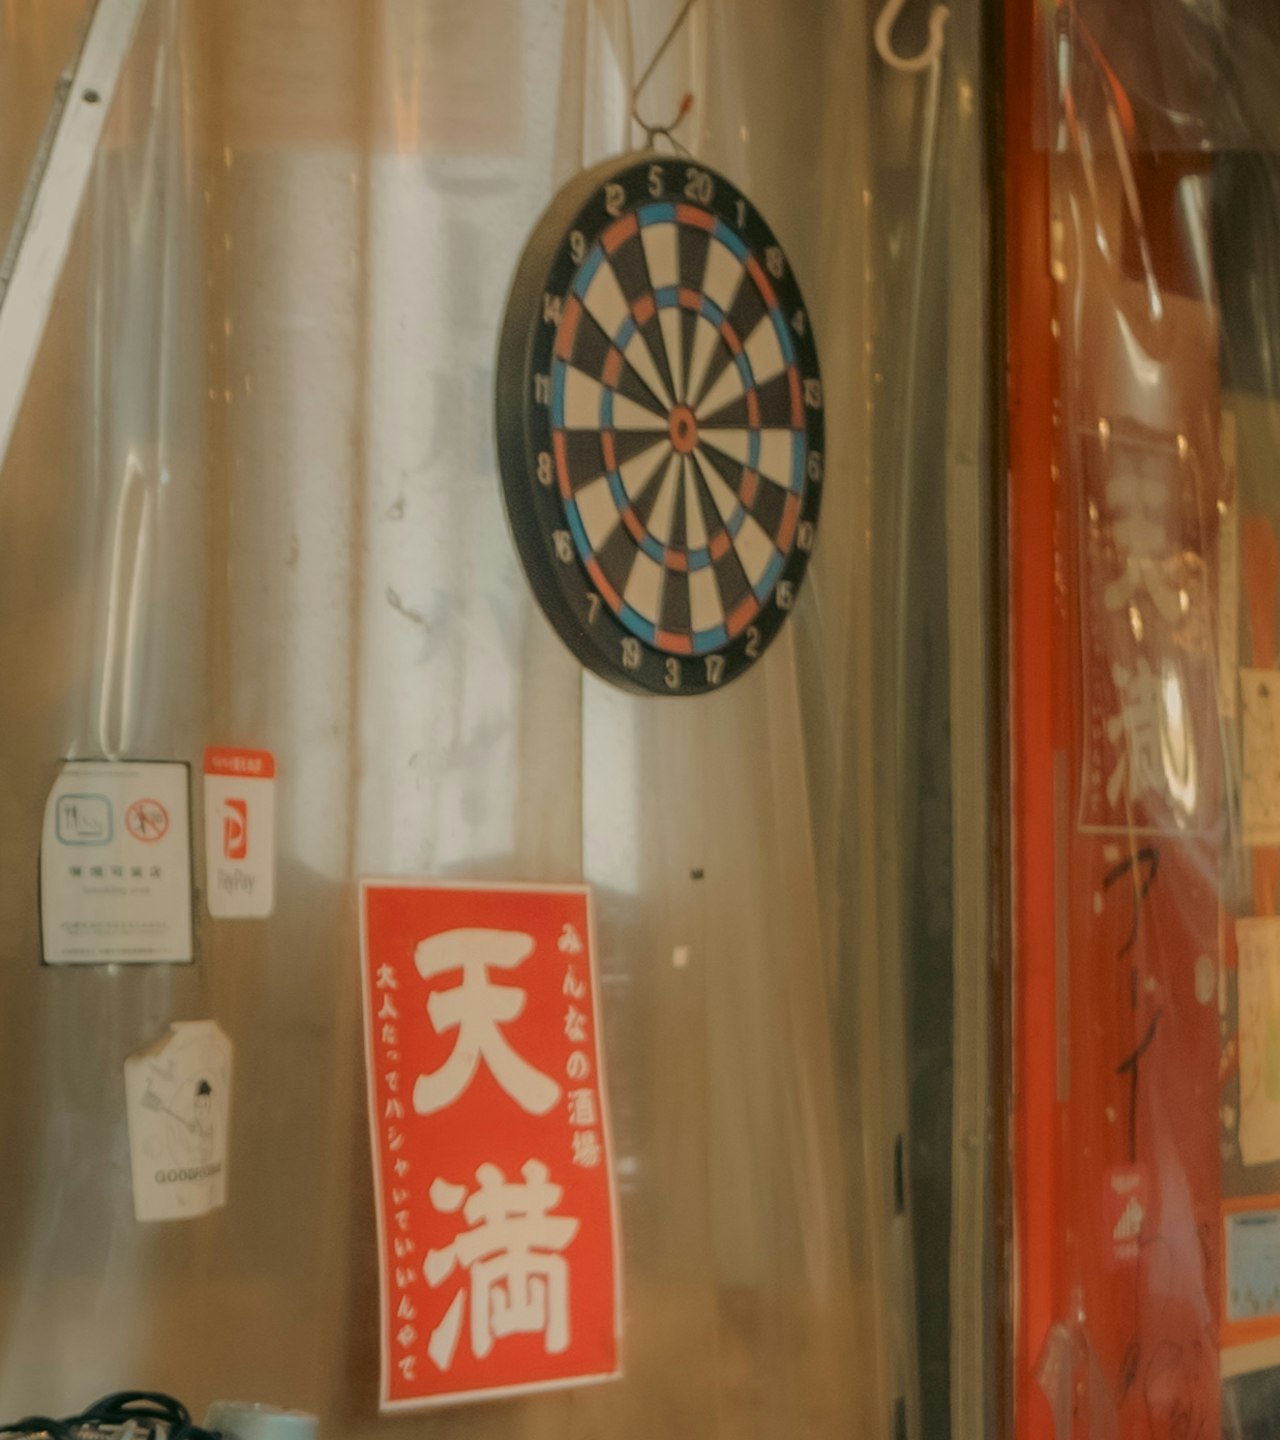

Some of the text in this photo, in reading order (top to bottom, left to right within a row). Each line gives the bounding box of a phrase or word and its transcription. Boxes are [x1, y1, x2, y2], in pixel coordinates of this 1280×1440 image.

[647, 166, 665, 198] 5
[684, 166, 714, 204] 20
[605, 183, 627, 215] 12
[735, 199, 747, 228] 1
[569, 231, 585, 262] 9
[542, 292, 564, 324] 14
[533, 374, 550, 405] 11
[535, 450, 553, 486] 8
[807, 451, 822, 482] 6
[553, 528, 573, 562] 16
[586, 592, 601, 623] 7
[775, 578, 793, 612] 15
[621, 635, 642, 669] 19
[746, 625, 763, 658] 2
[664, 656, 682, 689] 3
[705, 654, 726, 685] 17
[557, 921, 601, 1169] みんなの酒場
[411, 926, 582, 1373] 天満
